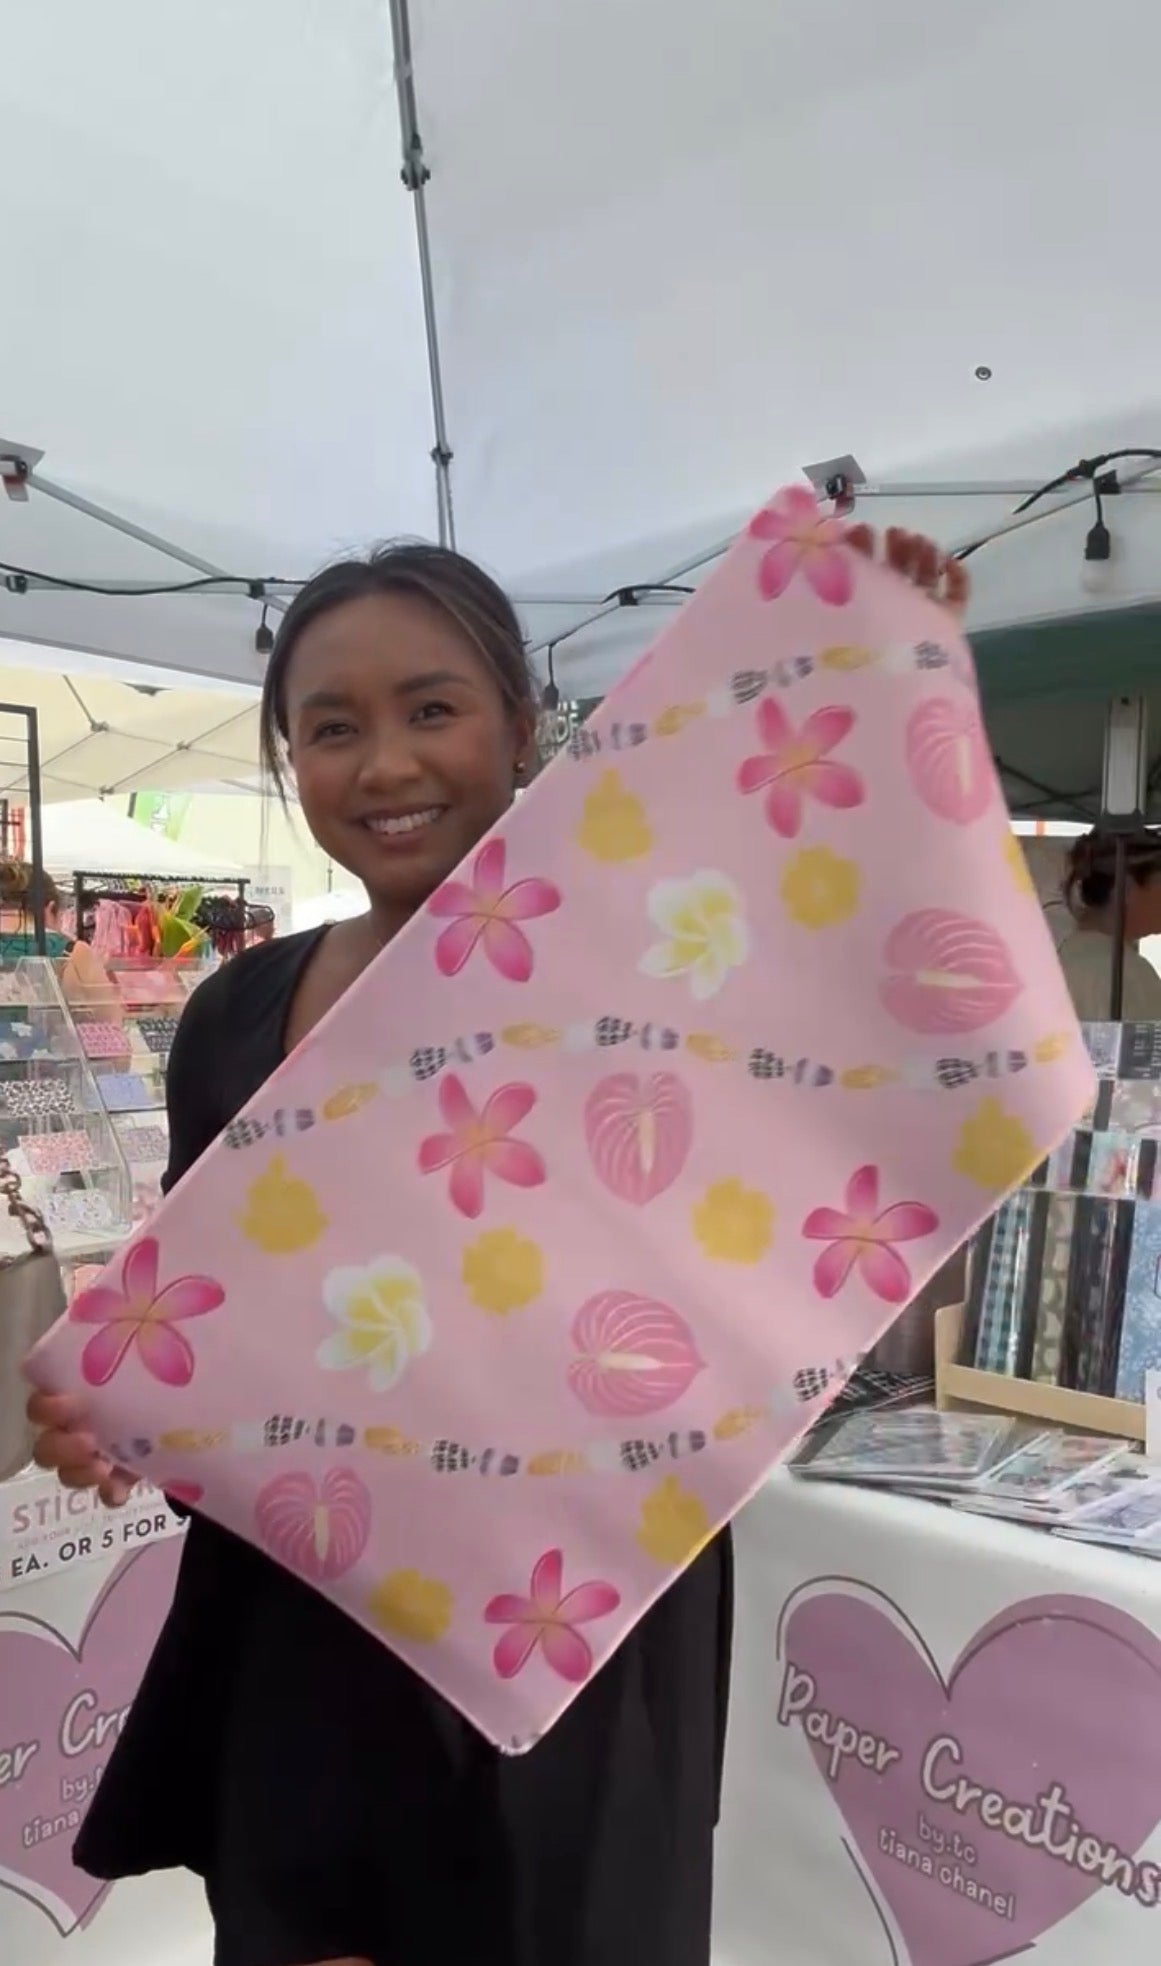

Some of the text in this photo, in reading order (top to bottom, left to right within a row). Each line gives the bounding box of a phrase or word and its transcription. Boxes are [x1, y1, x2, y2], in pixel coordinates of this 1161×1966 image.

[11, 1553, 48, 1578] EA.
[58, 1536, 92, 1562] OR
[101, 1528, 114, 1549] 5
[123, 1514, 166, 1543] FOR
[779, 1661, 1161, 1908] Paper Creations
[22, 1810, 81, 1848] tiana
[879, 1827, 934, 1876] tiana
